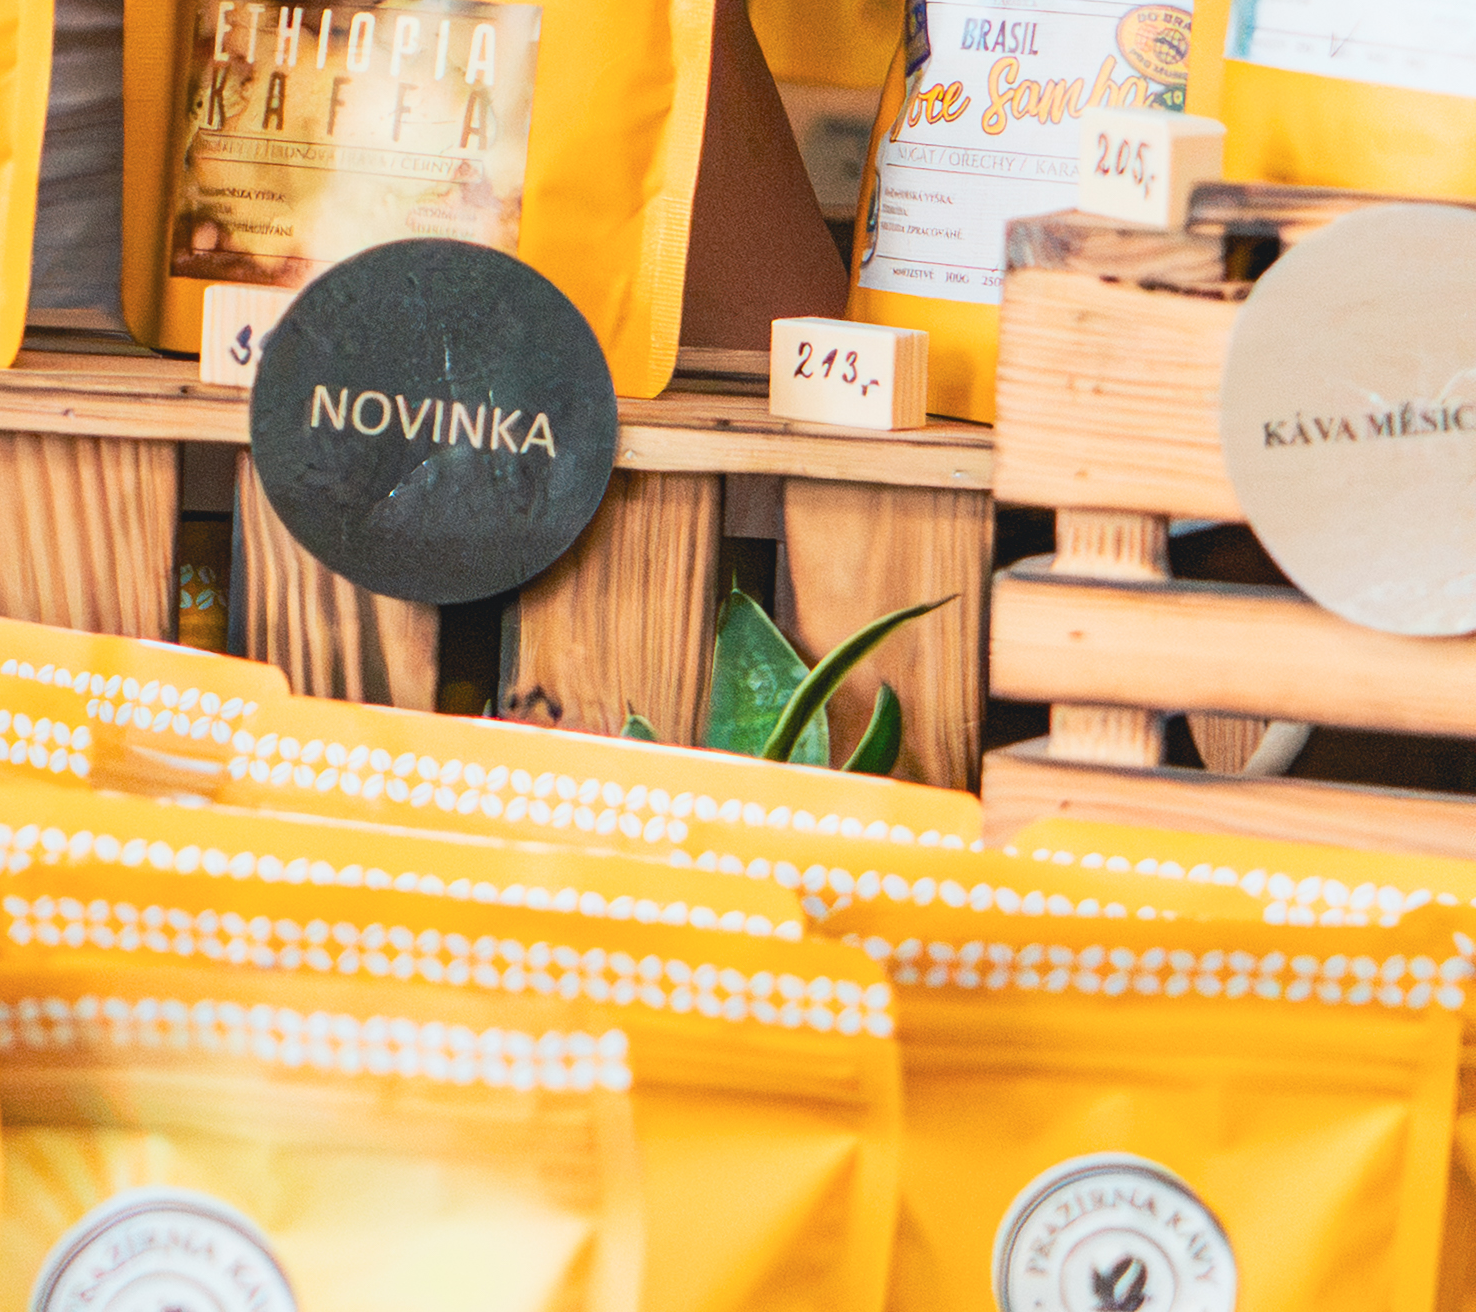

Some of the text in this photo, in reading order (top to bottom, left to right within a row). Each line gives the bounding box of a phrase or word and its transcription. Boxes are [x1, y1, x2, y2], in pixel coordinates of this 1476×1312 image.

[212, 0, 497, 86] ETHIOPIA
[960, 19, 1040, 57] BRASIL
[205, 63, 489, 152] KAFFA
[909, 54, 1159, 136] oce Samba
[948, 149, 1016, 172] OŘECHY
[309, 383, 557, 459] NOVINKA
[1262, 410, 1358, 450] KÁVA
